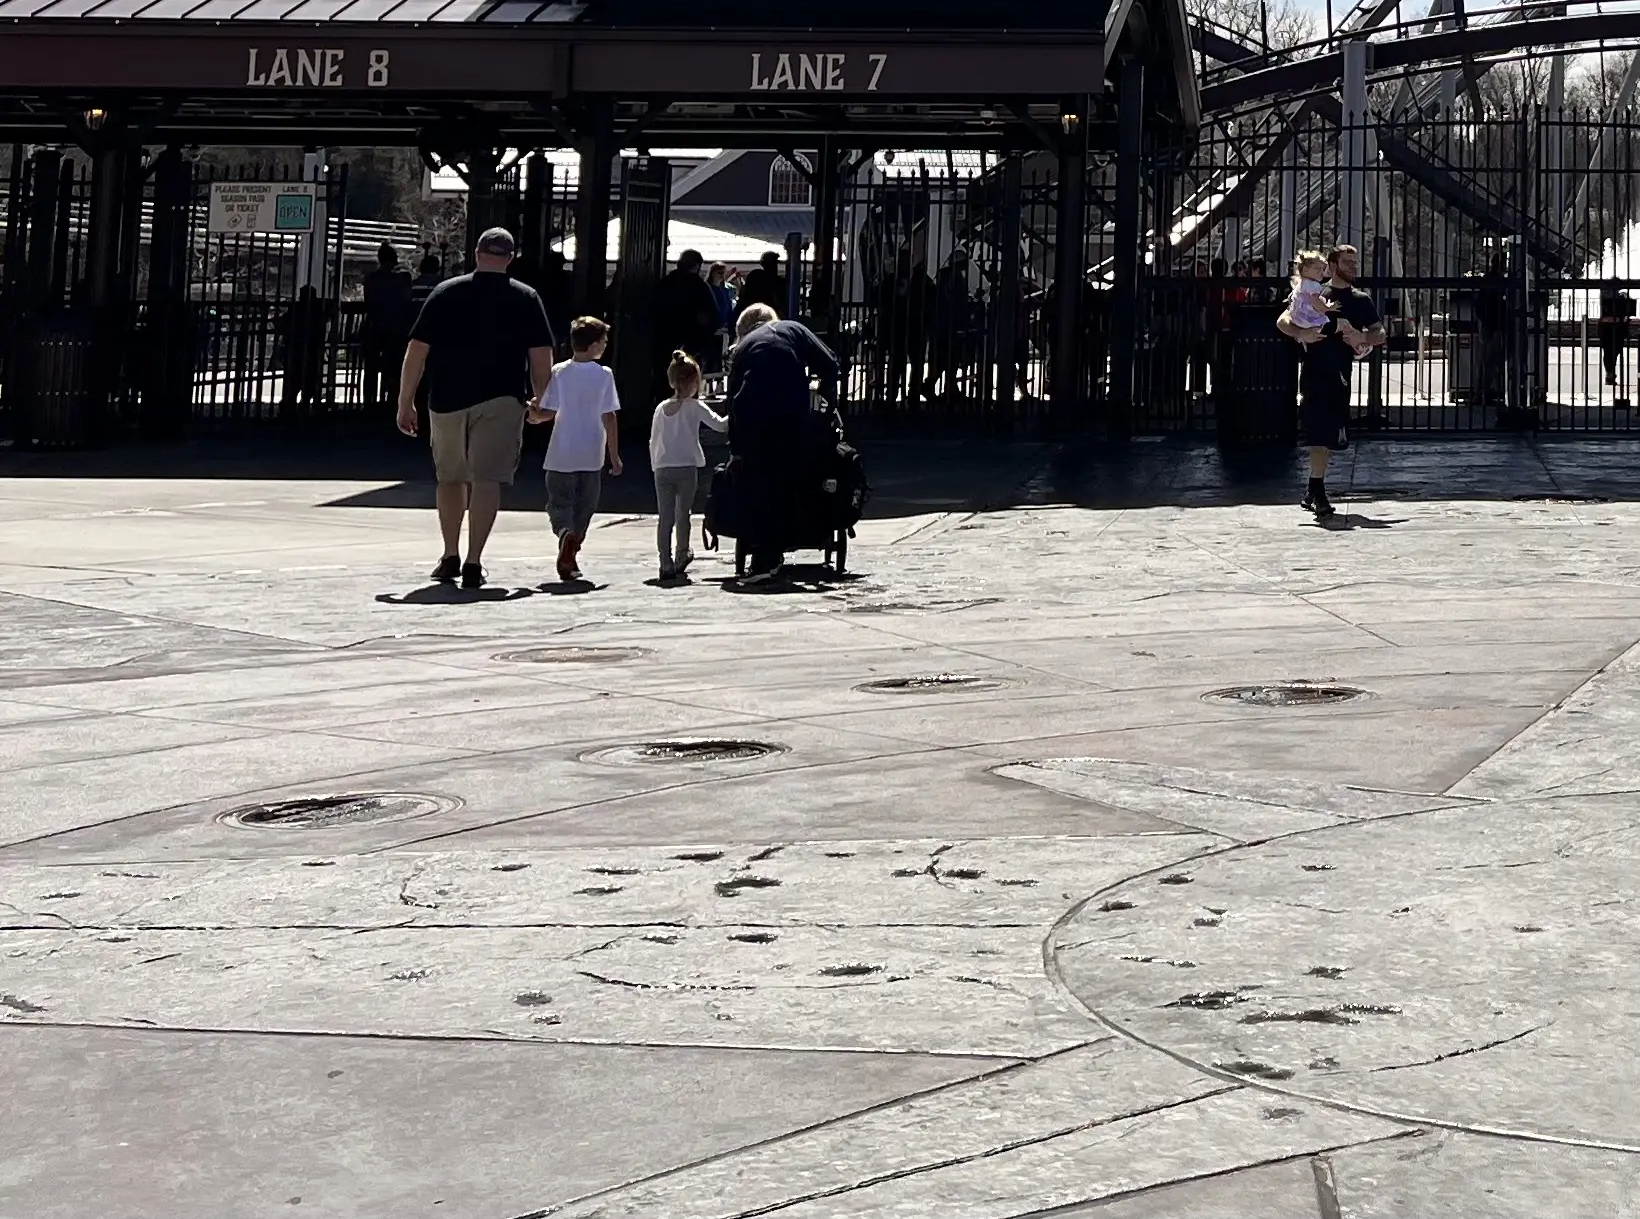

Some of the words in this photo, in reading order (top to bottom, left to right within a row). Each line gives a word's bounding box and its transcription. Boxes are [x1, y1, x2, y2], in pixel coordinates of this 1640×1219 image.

[246, 48, 345, 87] LANE
[367, 49, 390, 87] 8
[749, 53, 846, 91] LANE
[867, 54, 887, 91] 7
[280, 205, 307, 218] OPEN
